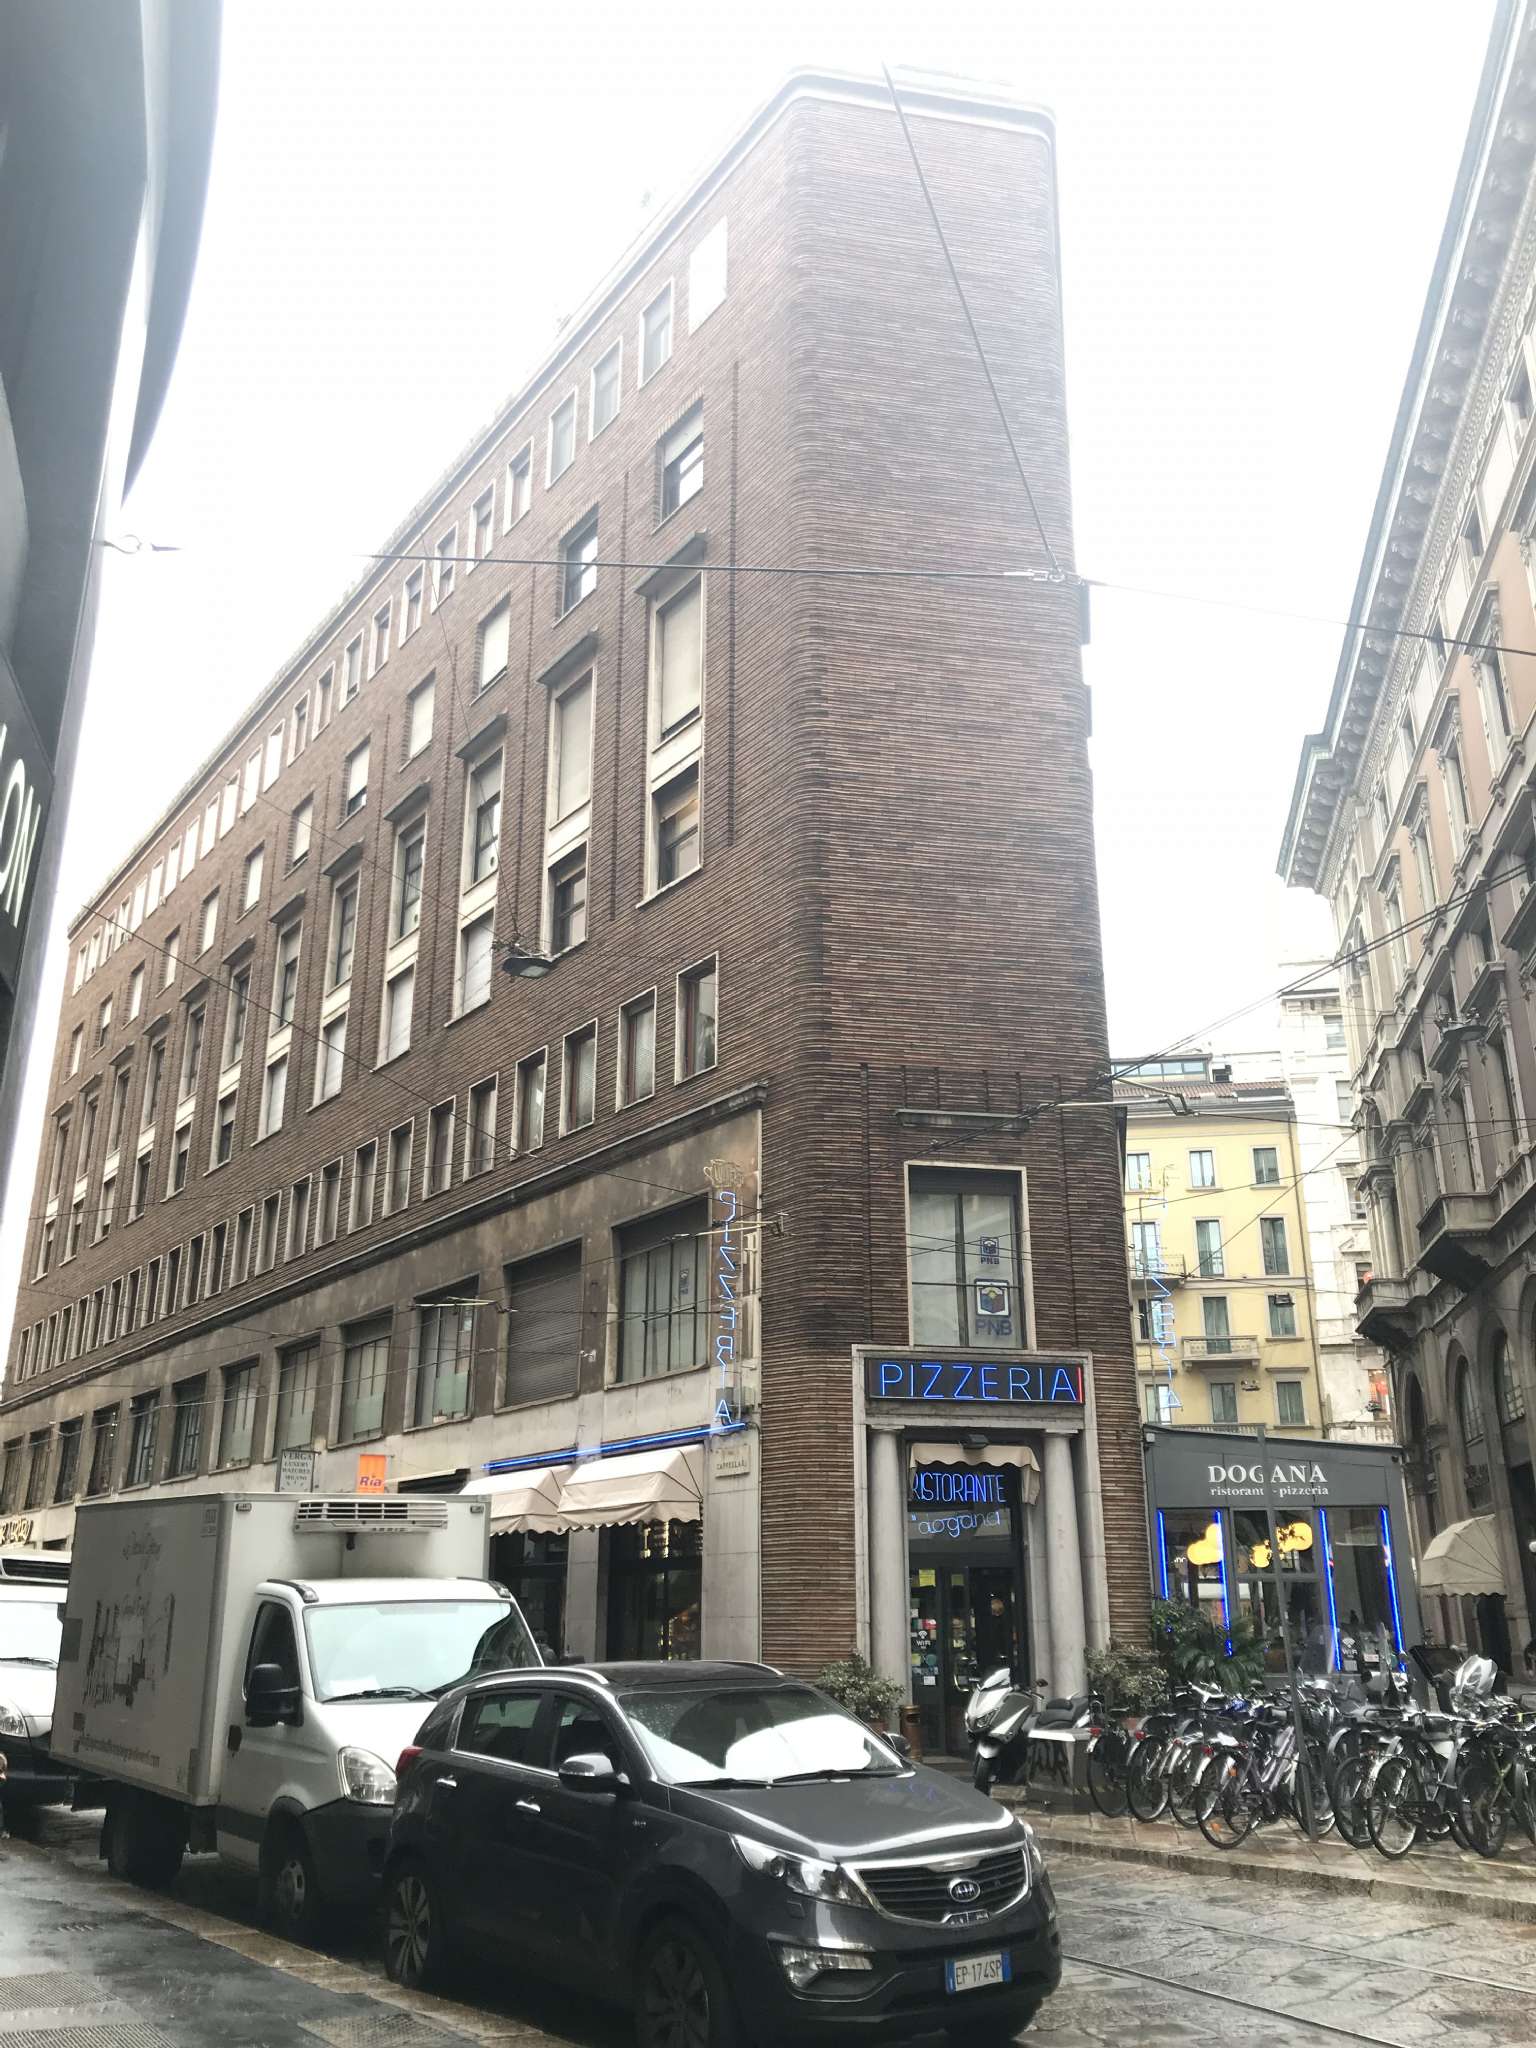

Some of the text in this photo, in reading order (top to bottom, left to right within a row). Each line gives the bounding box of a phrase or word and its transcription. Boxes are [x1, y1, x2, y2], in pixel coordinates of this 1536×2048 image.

[980, 1257, 1000, 1265] PNB
[975, 1318, 1012, 1336] PNB
[880, 1363, 1078, 1401] PIZZERIA
[283, 1452, 312, 1461] VERGA
[359, 1474, 384, 1487] Ria
[1208, 1465, 1328, 1483] DOGANA
[912, 1471, 1007, 1503] RISTORANTE
[1210, 1485, 1265, 1496] ristorant
[1279, 1485, 1329, 1498] pizzeria
